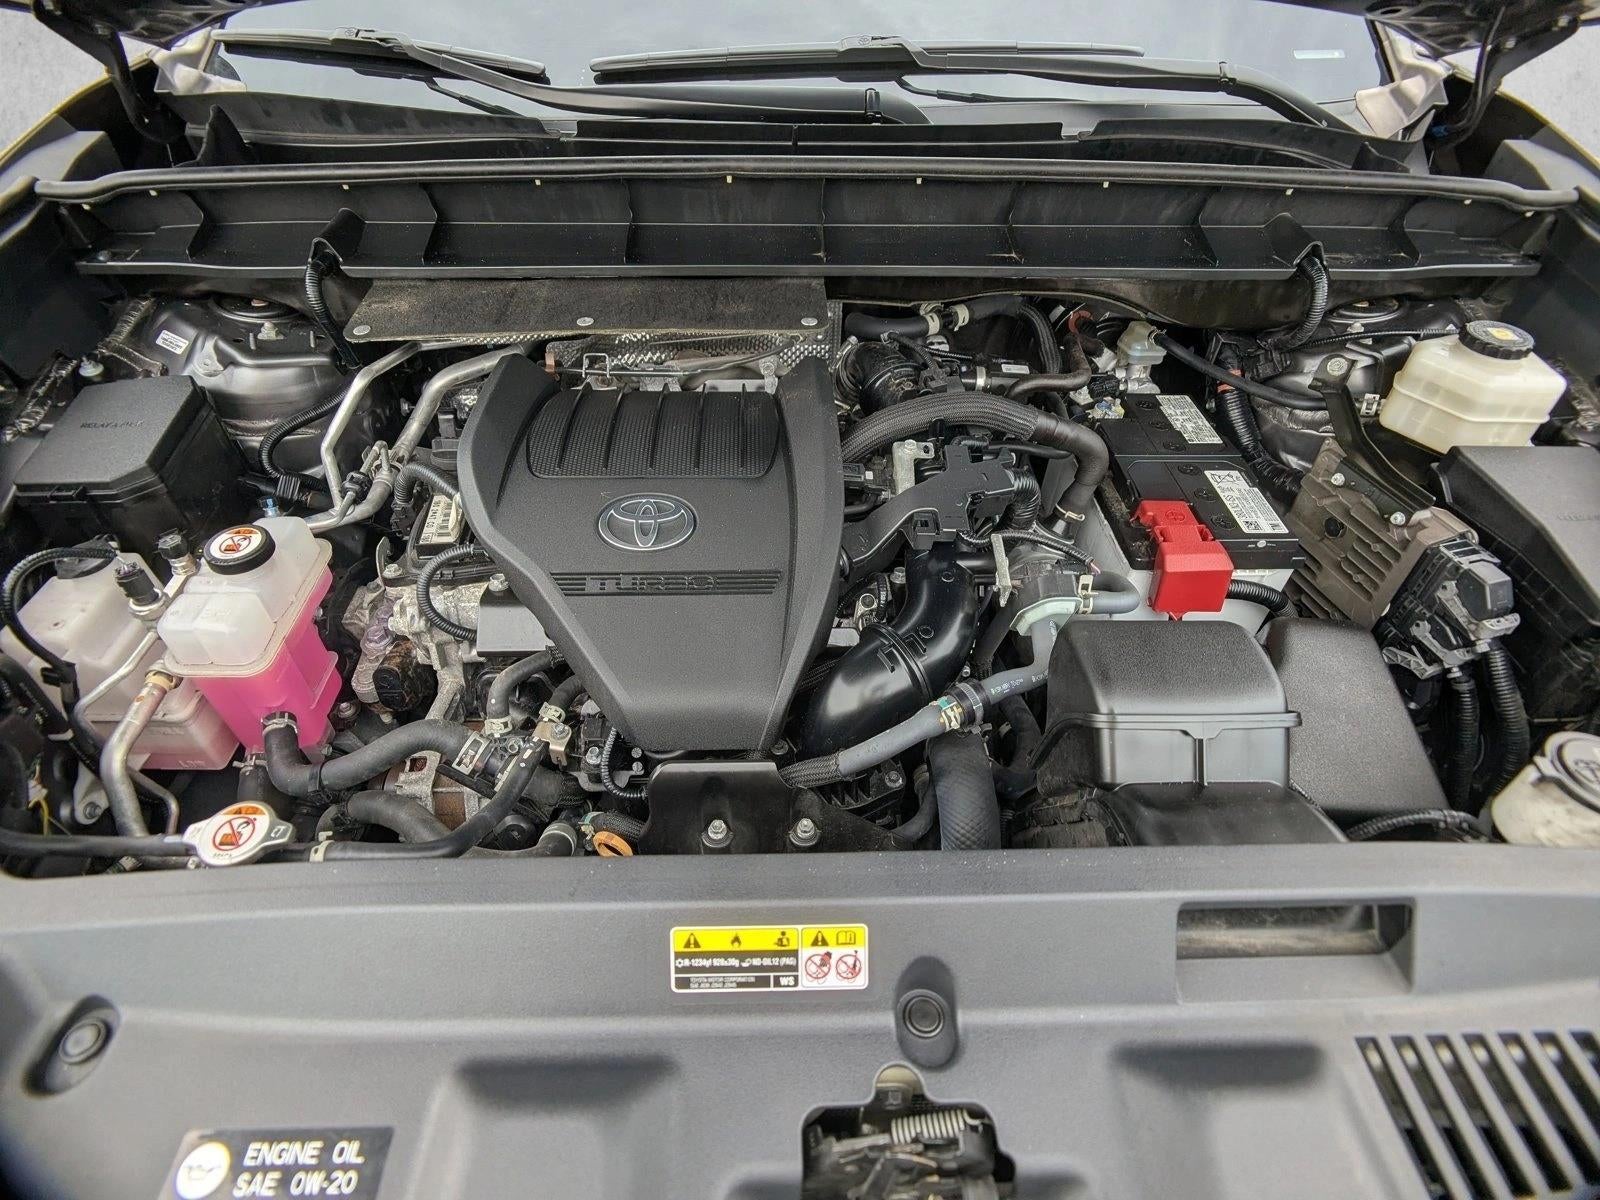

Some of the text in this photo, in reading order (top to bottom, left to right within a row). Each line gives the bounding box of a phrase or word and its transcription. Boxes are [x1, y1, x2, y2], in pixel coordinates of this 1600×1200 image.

[588, 574, 720, 592] TURBO
[779, 977, 795, 986] WS
[242, 1140, 366, 1167] ENGINE OIL
[232, 1170, 283, 1198] SAE
